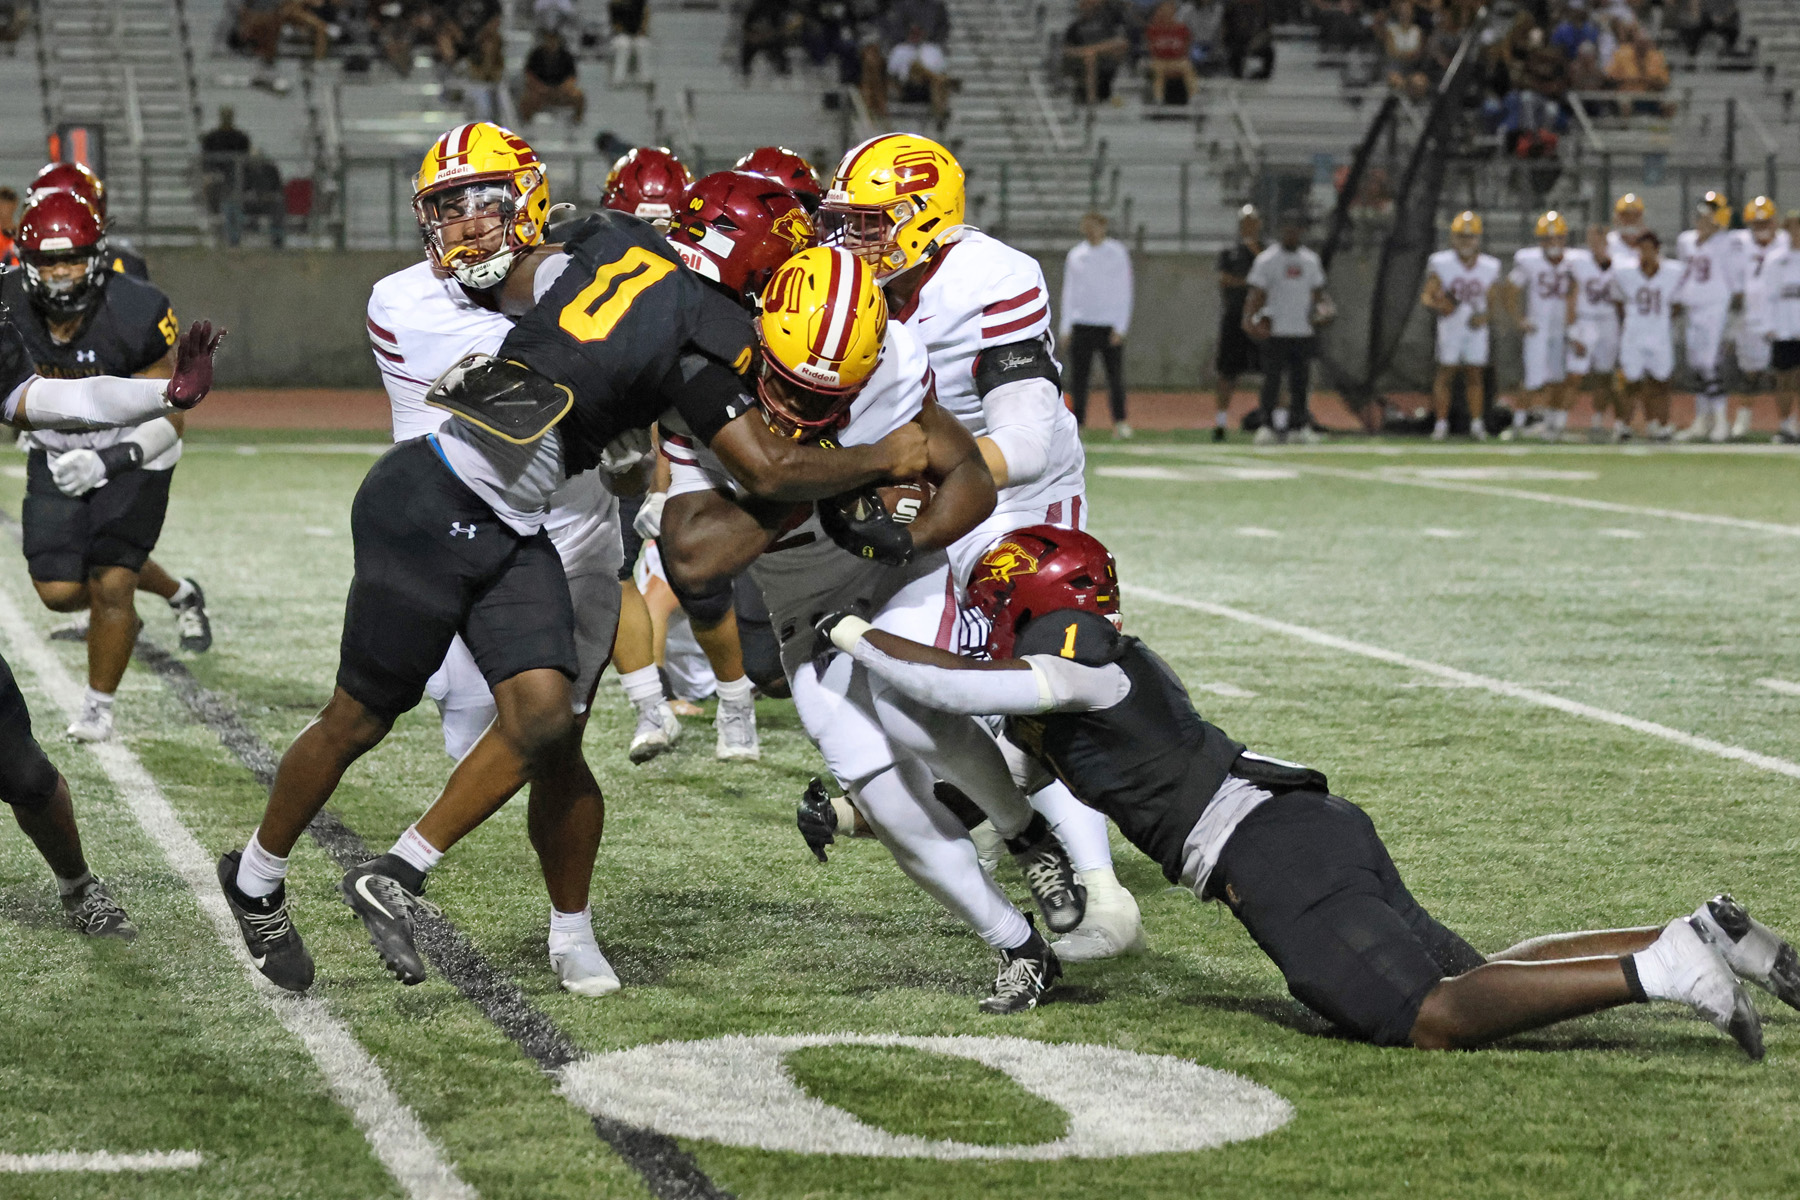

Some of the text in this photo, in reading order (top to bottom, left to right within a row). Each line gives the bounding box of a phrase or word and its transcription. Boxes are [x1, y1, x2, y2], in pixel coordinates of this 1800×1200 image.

[437, 165, 469, 180] Riddell
[470, 262, 492, 275] Riddell
[558, 246, 678, 344] 0
[801, 366, 837, 383] Riddell
[1060, 622, 1079, 659] 1
